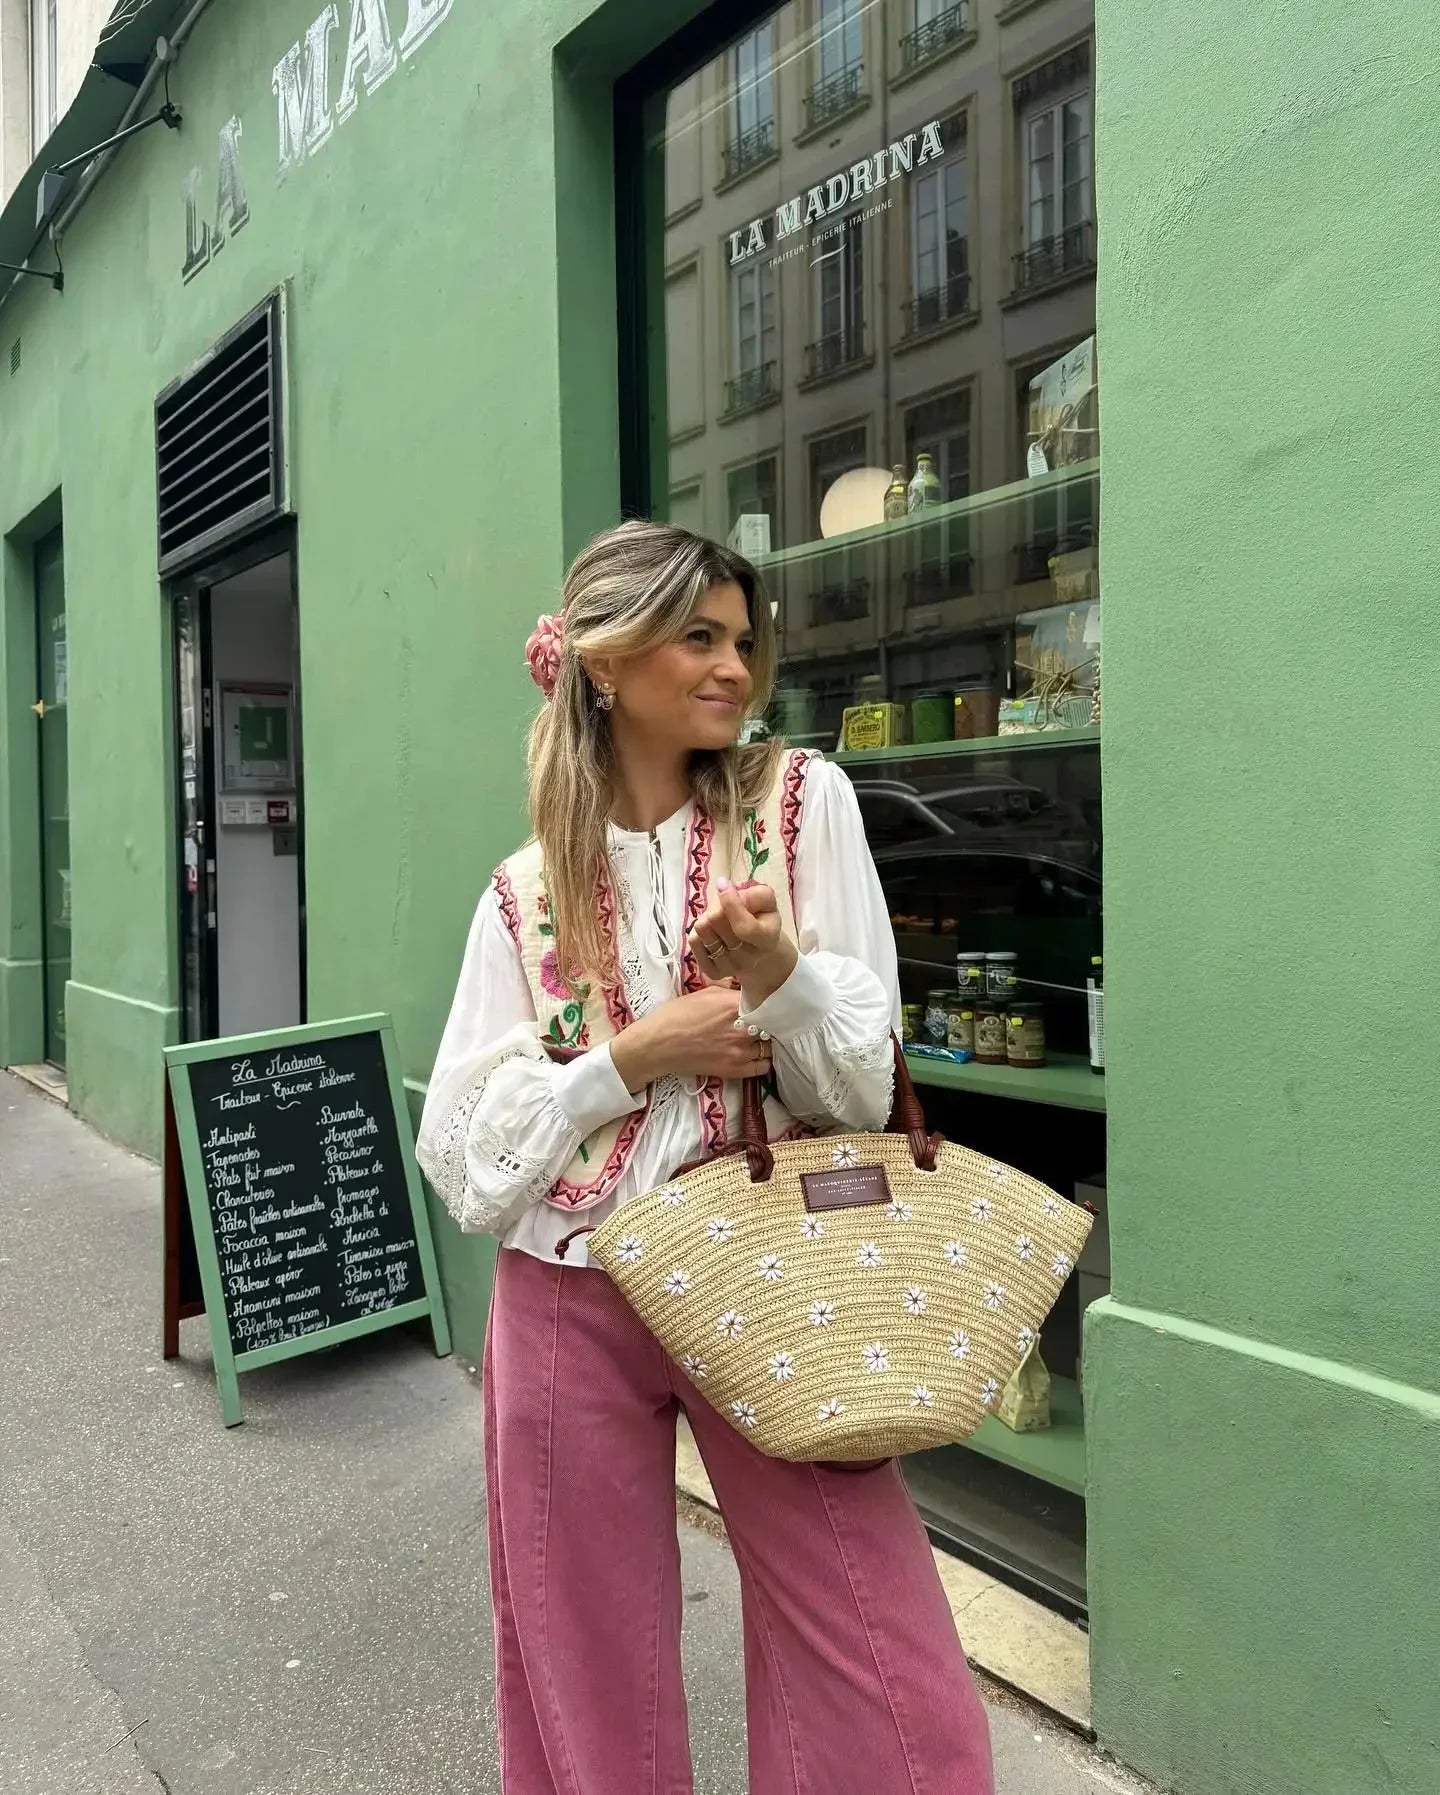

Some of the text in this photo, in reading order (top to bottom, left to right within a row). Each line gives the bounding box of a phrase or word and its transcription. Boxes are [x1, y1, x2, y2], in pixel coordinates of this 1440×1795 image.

[181, 114, 250, 287] LA
[729, 120, 945, 265] LA MADRINA
[768, 244, 804, 270] TRAITEUR
[811, 222, 847, 247] EPICERIE
[849, 198, 894, 227] ITALIENNE
[231, 1053, 326, 1083] La Madrina
[210, 1089, 261, 1110] Traiteur
[319, 1068, 356, 1088] italienne
[321, 1100, 366, 1124] Burrata
[207, 1122, 257, 1148] Antipasti
[206, 1147, 260, 1170] Tapenades
[328, 1160, 384, 1184] Plateaux de
[212, 1162, 295, 1191] Plats fait maison
[216, 1185, 275, 1209] Charcuteries
[283, 1194, 325, 1218] artisanales
[337, 1187, 379, 1208] fromages
[379, 1201, 390, 1216] di
[222, 1226, 307, 1254] Focaccia maison
[225, 1233, 328, 1274] Huile d'olive artisanale
[337, 1237, 415, 1265] Tiramisu maison
[229, 1265, 304, 1296] Plateaux apéro
[375, 1262, 382, 1277] à
[384, 1258, 408, 1281] pizza
[233, 1285, 320, 1317] Arancini maison
[236, 1307, 319, 1338] Polpettes maison
